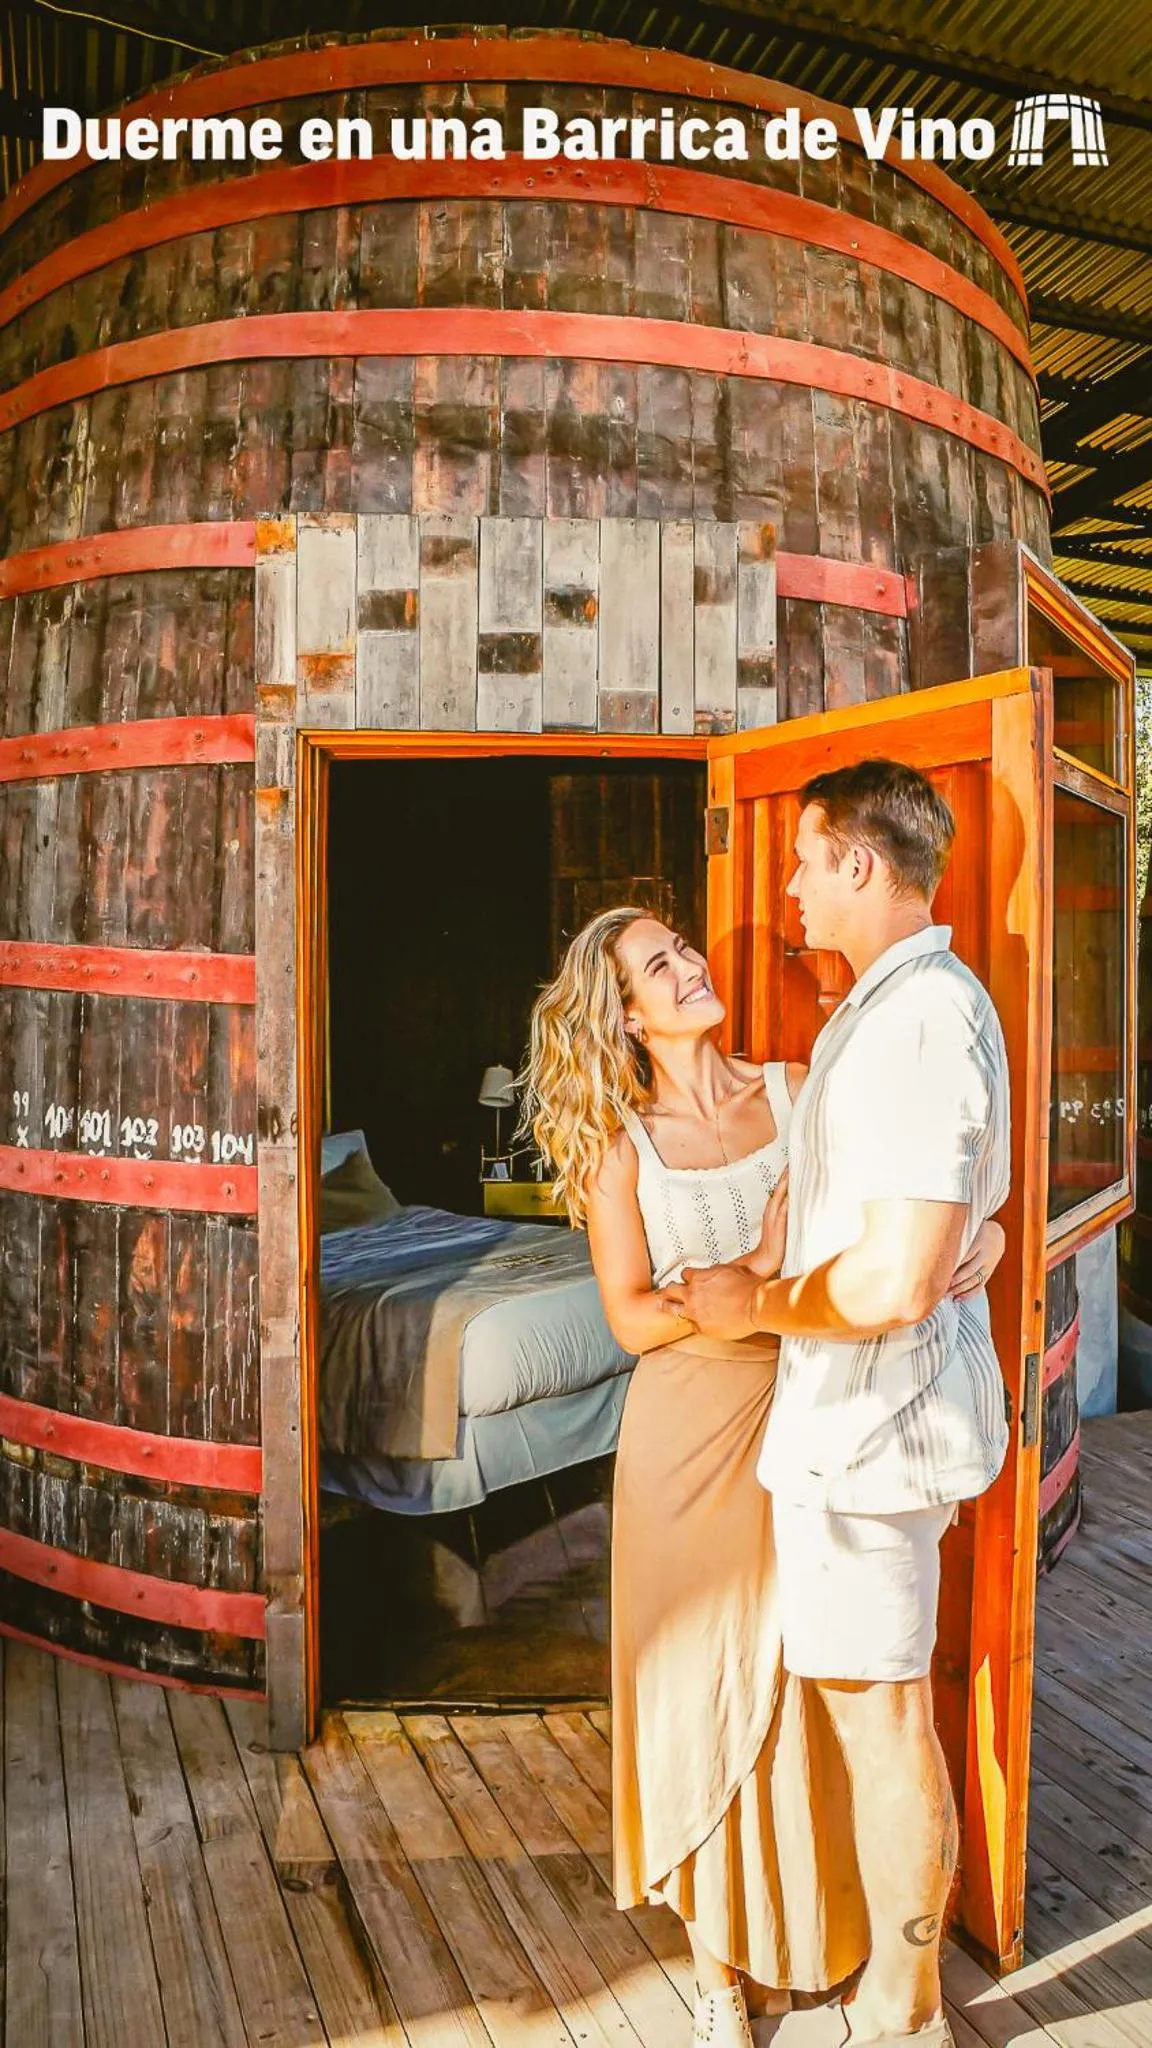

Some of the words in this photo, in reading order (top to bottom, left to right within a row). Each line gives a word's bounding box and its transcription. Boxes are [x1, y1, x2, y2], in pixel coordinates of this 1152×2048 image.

[13, 1090, 30, 1118] 99
[79, 1108, 113, 1148] 101
[120, 1115, 159, 1147] 102
[171, 1124, 206, 1153] 103
[211, 1130, 254, 1166] 104
